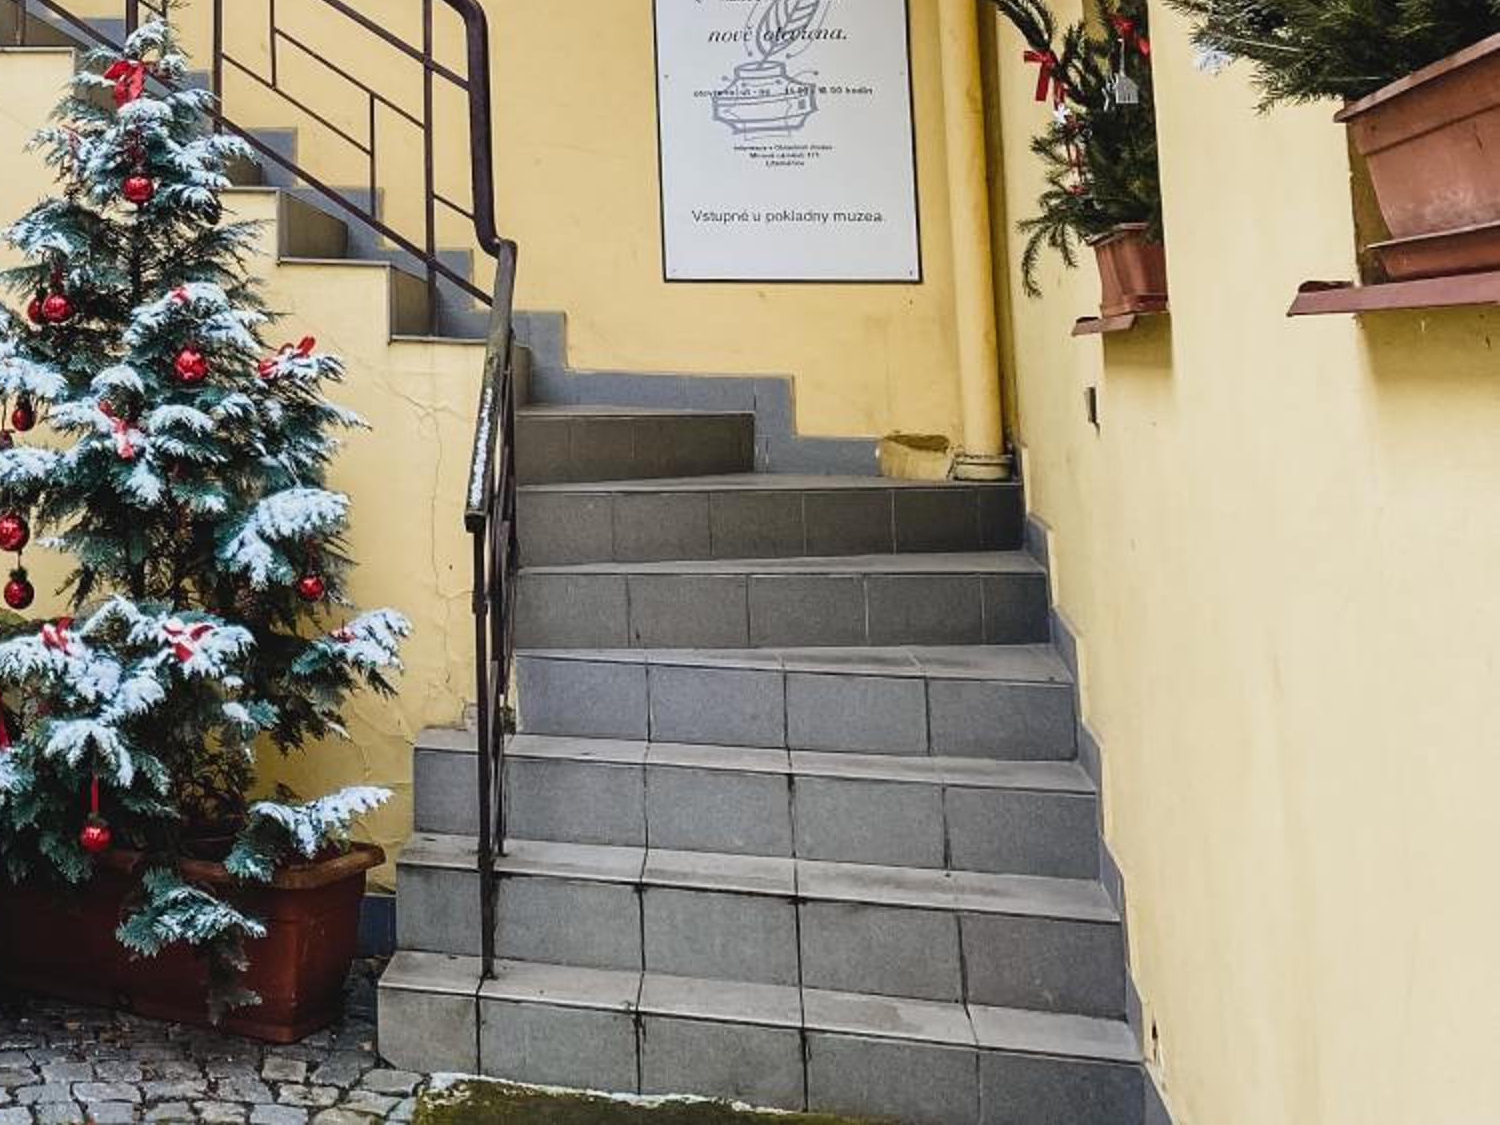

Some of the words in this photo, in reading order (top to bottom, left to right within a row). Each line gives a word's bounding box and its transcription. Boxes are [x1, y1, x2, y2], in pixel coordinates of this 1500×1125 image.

[691, 210, 749, 223] Vstupné
[753, 212, 761, 222] u
[766, 209, 828, 224] pokladny
